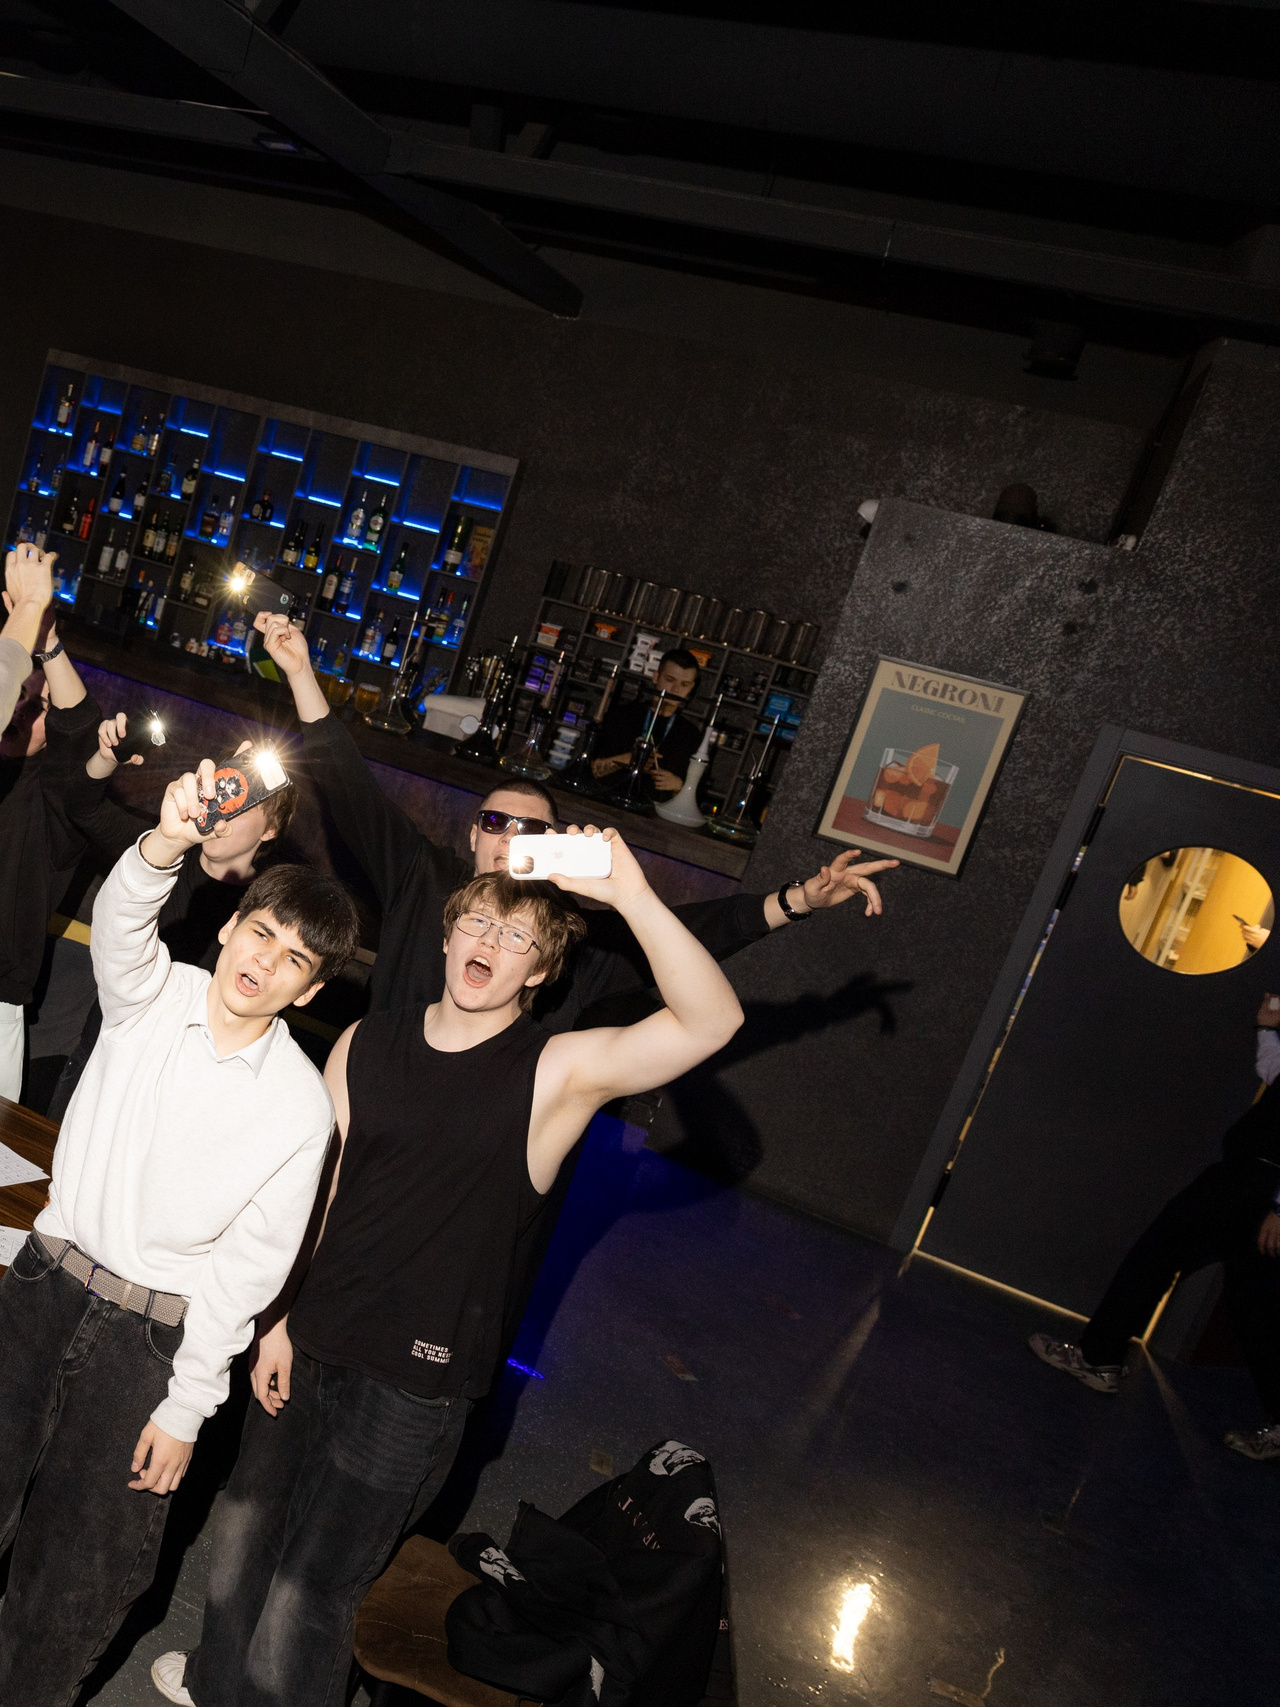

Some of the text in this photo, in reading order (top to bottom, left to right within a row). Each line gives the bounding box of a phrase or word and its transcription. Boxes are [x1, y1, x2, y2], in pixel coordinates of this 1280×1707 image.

[891, 671, 1005, 713] NEGRONI
[413, 1344, 422, 1352] ALL
[414, 1339, 449, 1352] SOMETIMES
[411, 1349, 425, 1359] COOL
